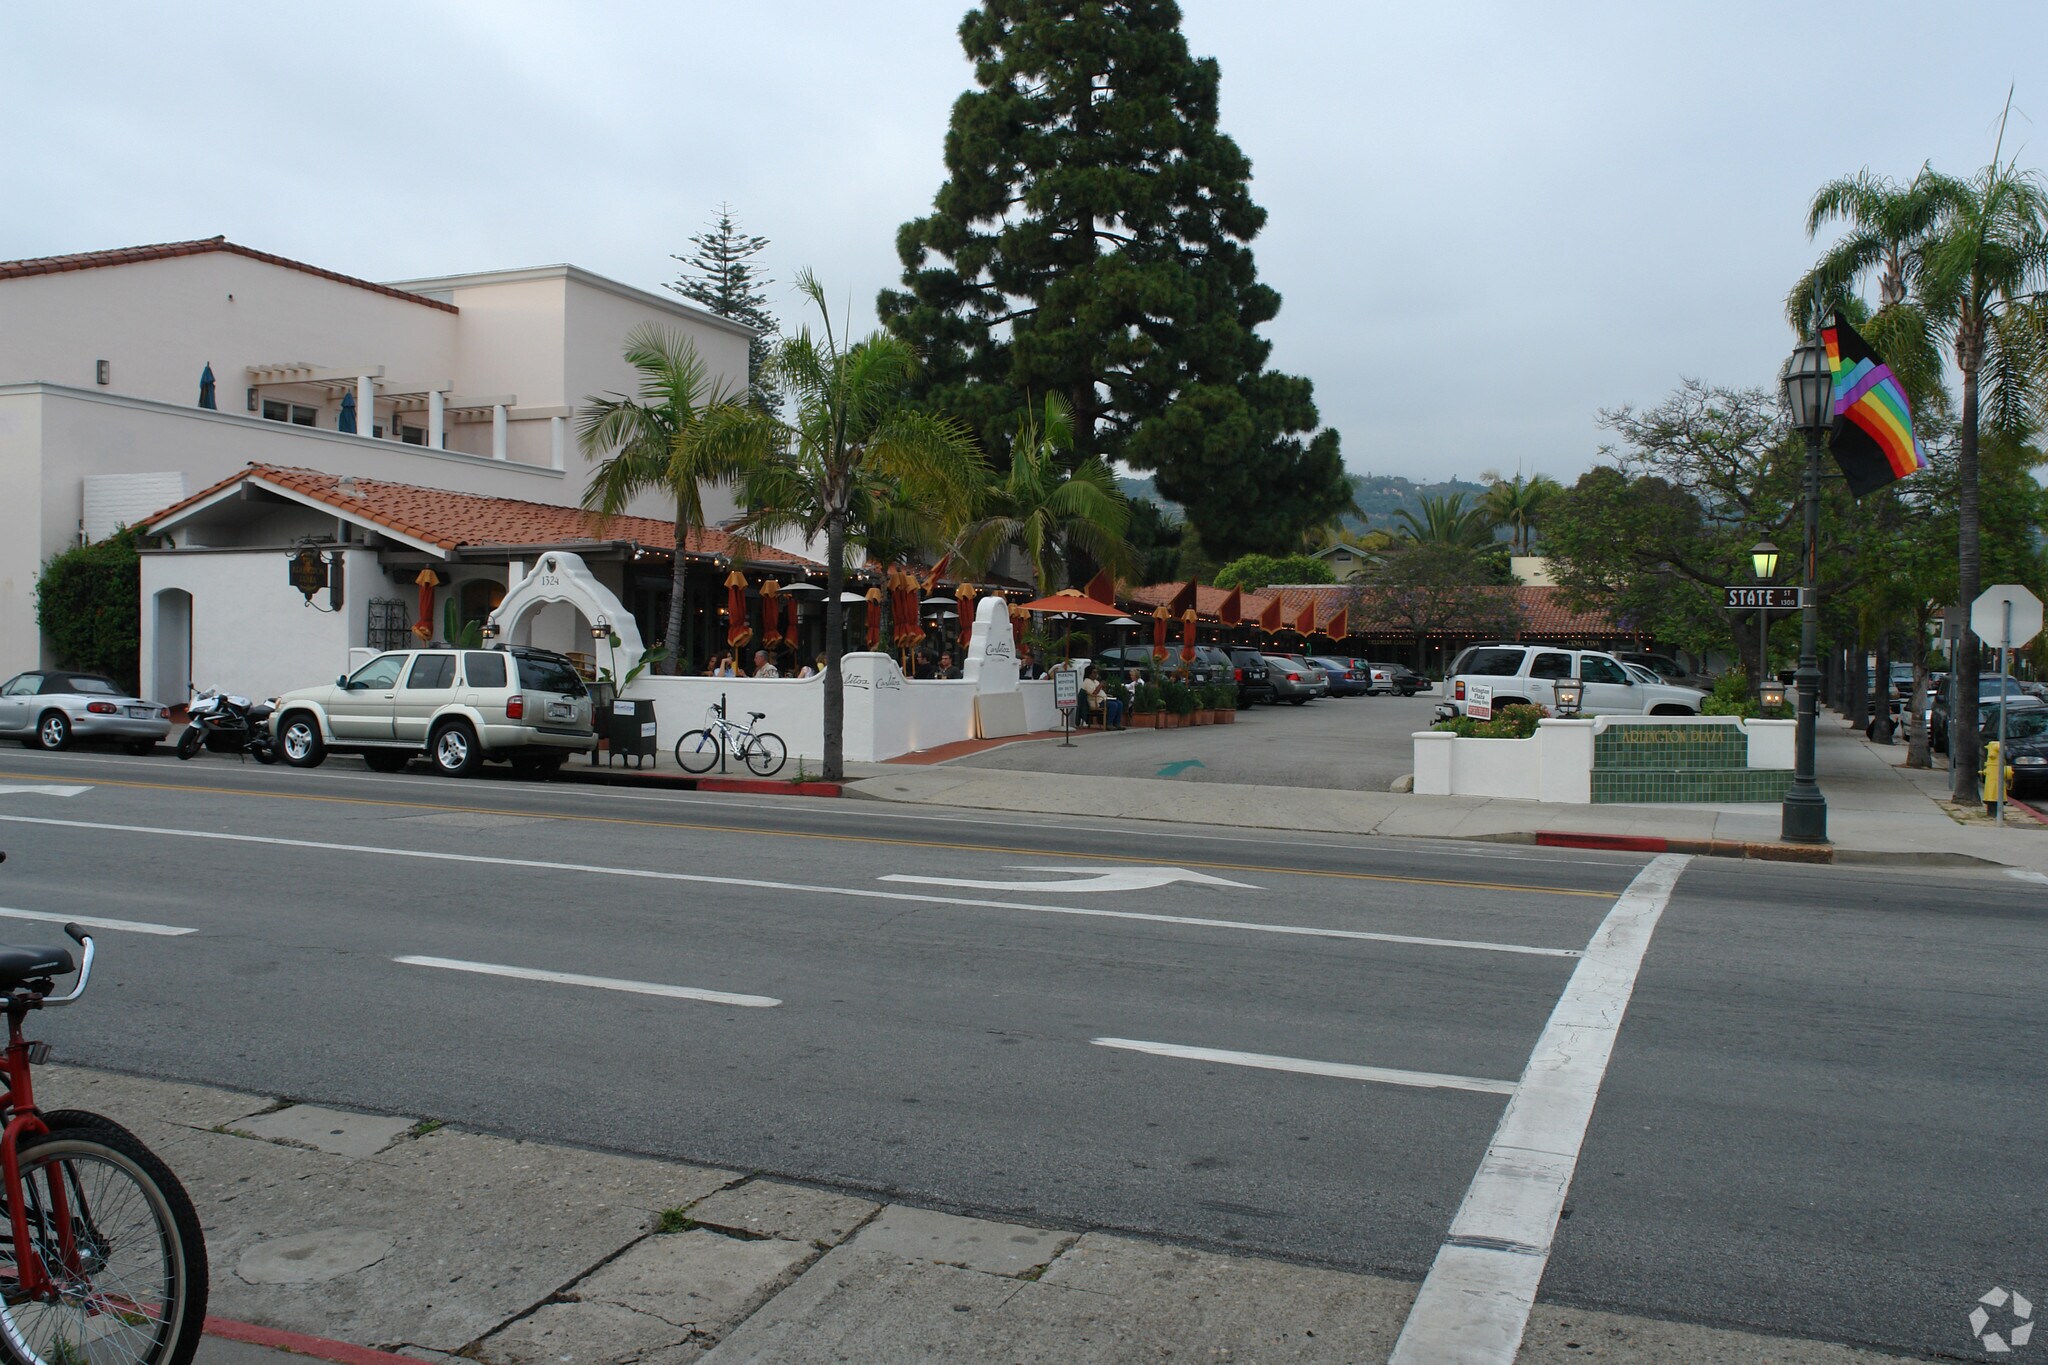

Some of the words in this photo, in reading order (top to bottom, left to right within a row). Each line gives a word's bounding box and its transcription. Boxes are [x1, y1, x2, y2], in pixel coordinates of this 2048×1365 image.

[541, 576, 559, 586] 1324
[1729, 589, 1774, 606] STATE
[1622, 730, 1686, 743] ARLINGTON
[1690, 730, 1724, 743] PLAZA
